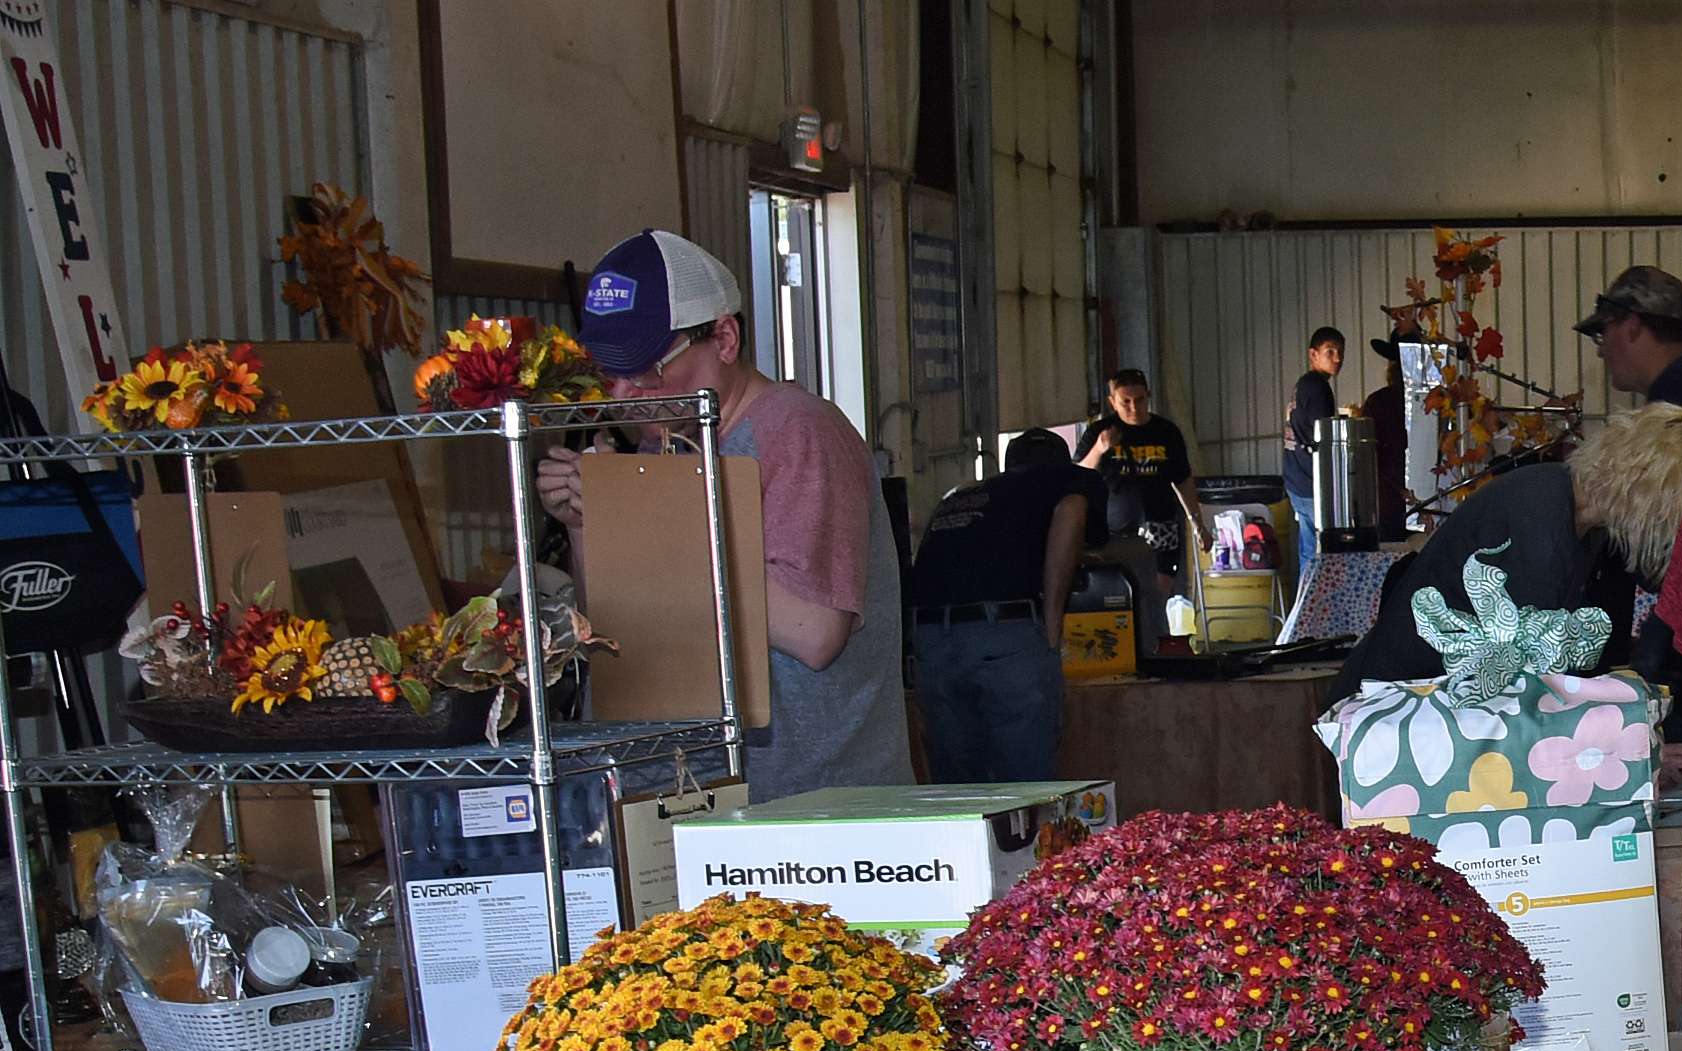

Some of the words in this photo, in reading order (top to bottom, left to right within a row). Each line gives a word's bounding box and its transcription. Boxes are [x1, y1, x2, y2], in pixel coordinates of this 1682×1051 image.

[1111, 445, 1167, 460] TERS
[1, 568, 76, 612] Fuller
[1454, 856, 1517, 872] Comforter
[1521, 855, 1541, 866] Set
[705, 862, 847, 886] Hamilton
[854, 859, 955, 883] Beach
[1468, 871, 1492, 882] with
[1494, 868, 1529, 880] Sheets
[411, 881, 493, 899] EVERCRAFT
[1511, 896, 1523, 913] 5
